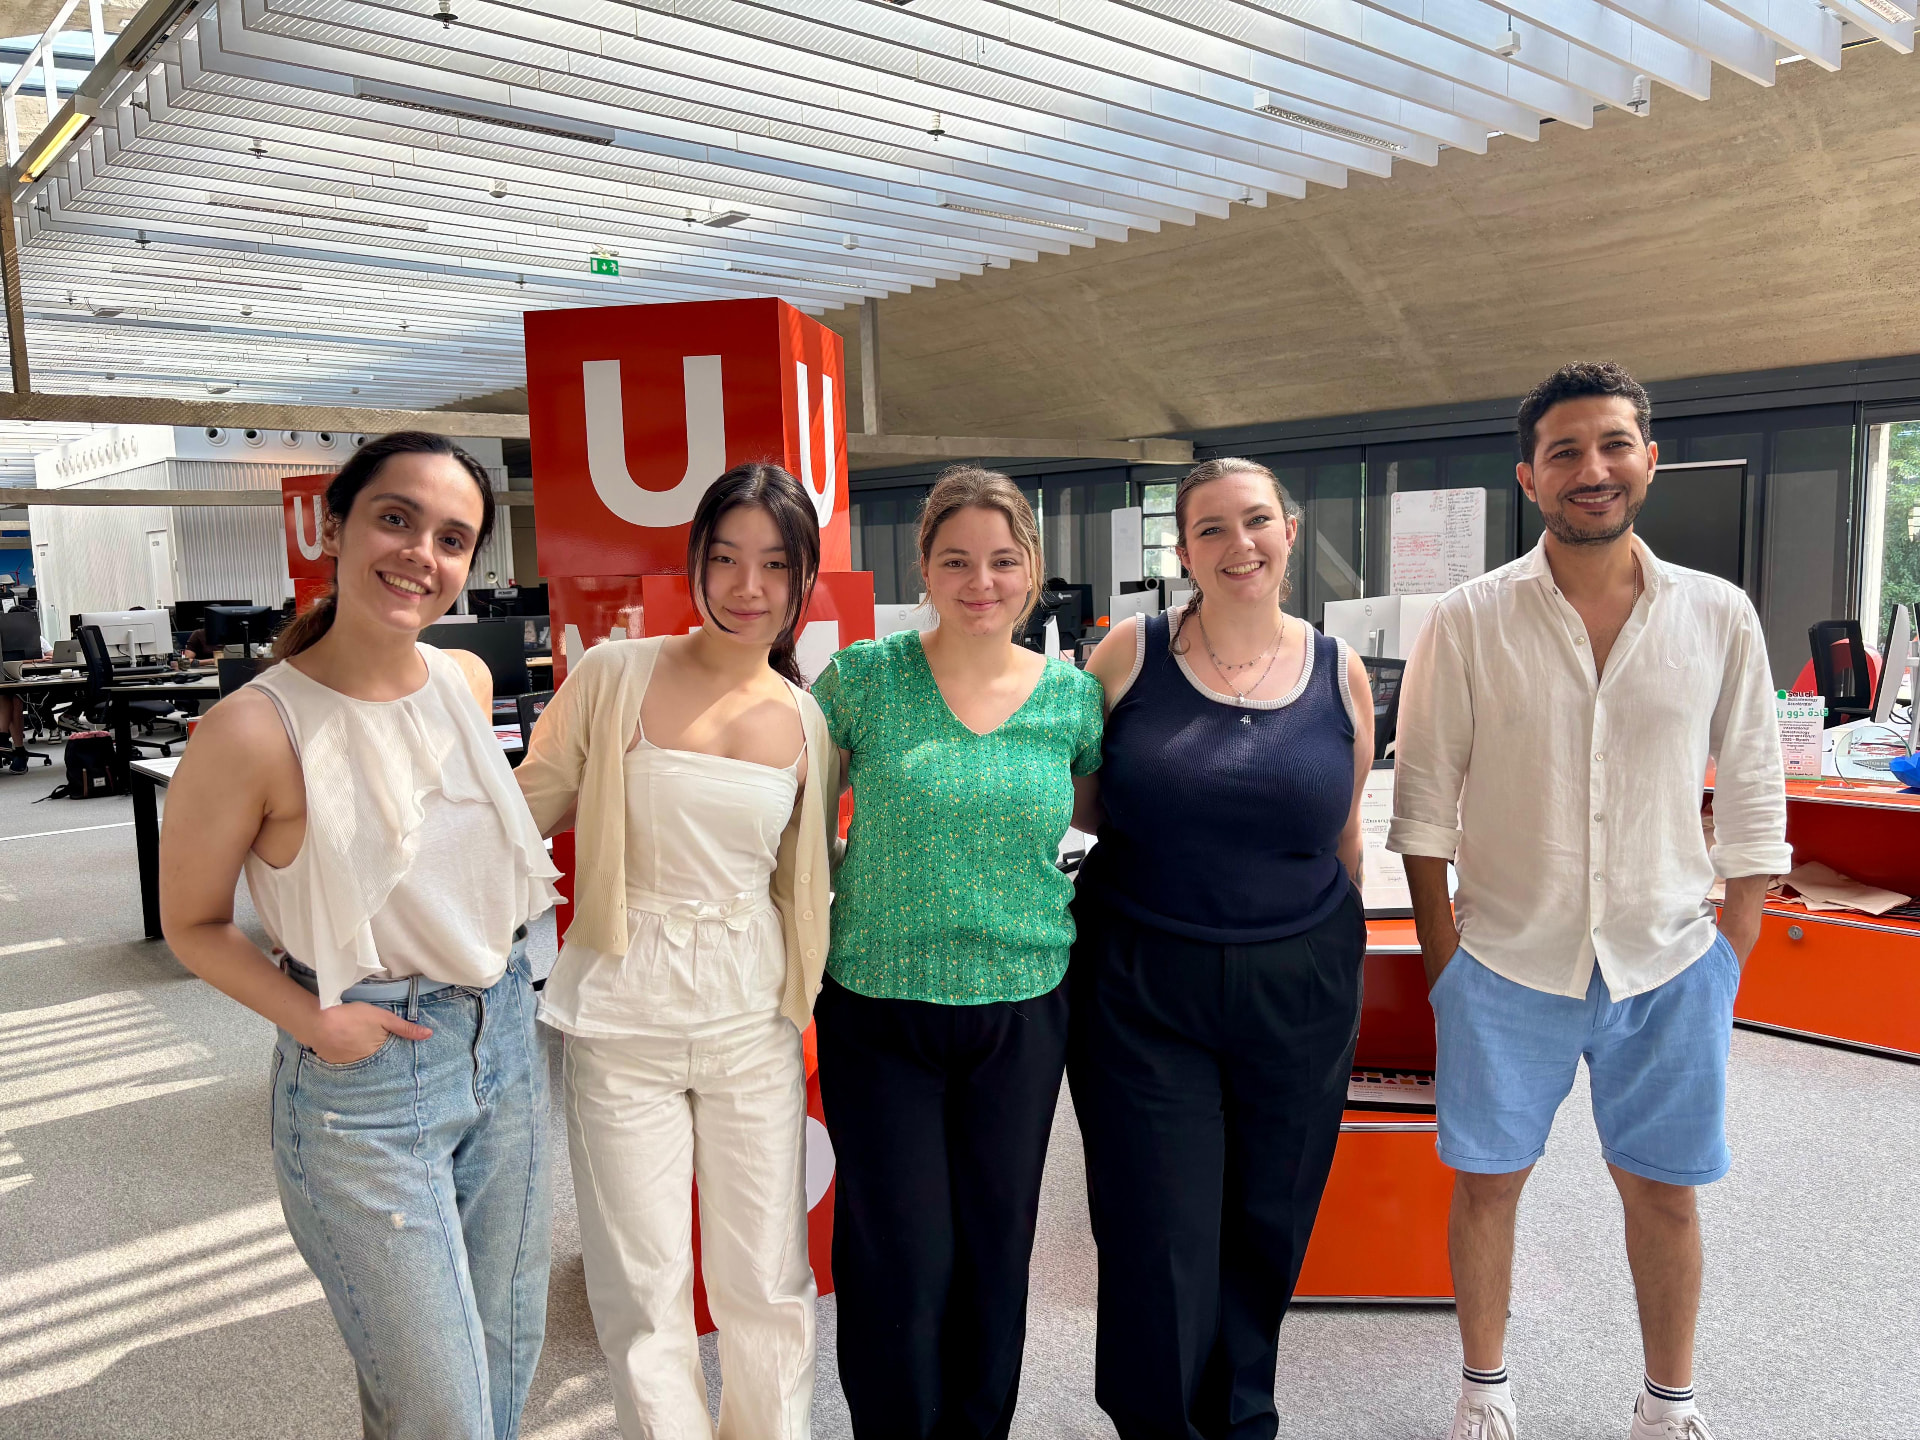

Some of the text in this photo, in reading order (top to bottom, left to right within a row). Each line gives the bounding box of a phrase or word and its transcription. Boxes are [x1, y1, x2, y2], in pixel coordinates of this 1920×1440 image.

[582, 354, 726, 528] U
[796, 360, 836, 528] U
[293, 494, 323, 561] U
